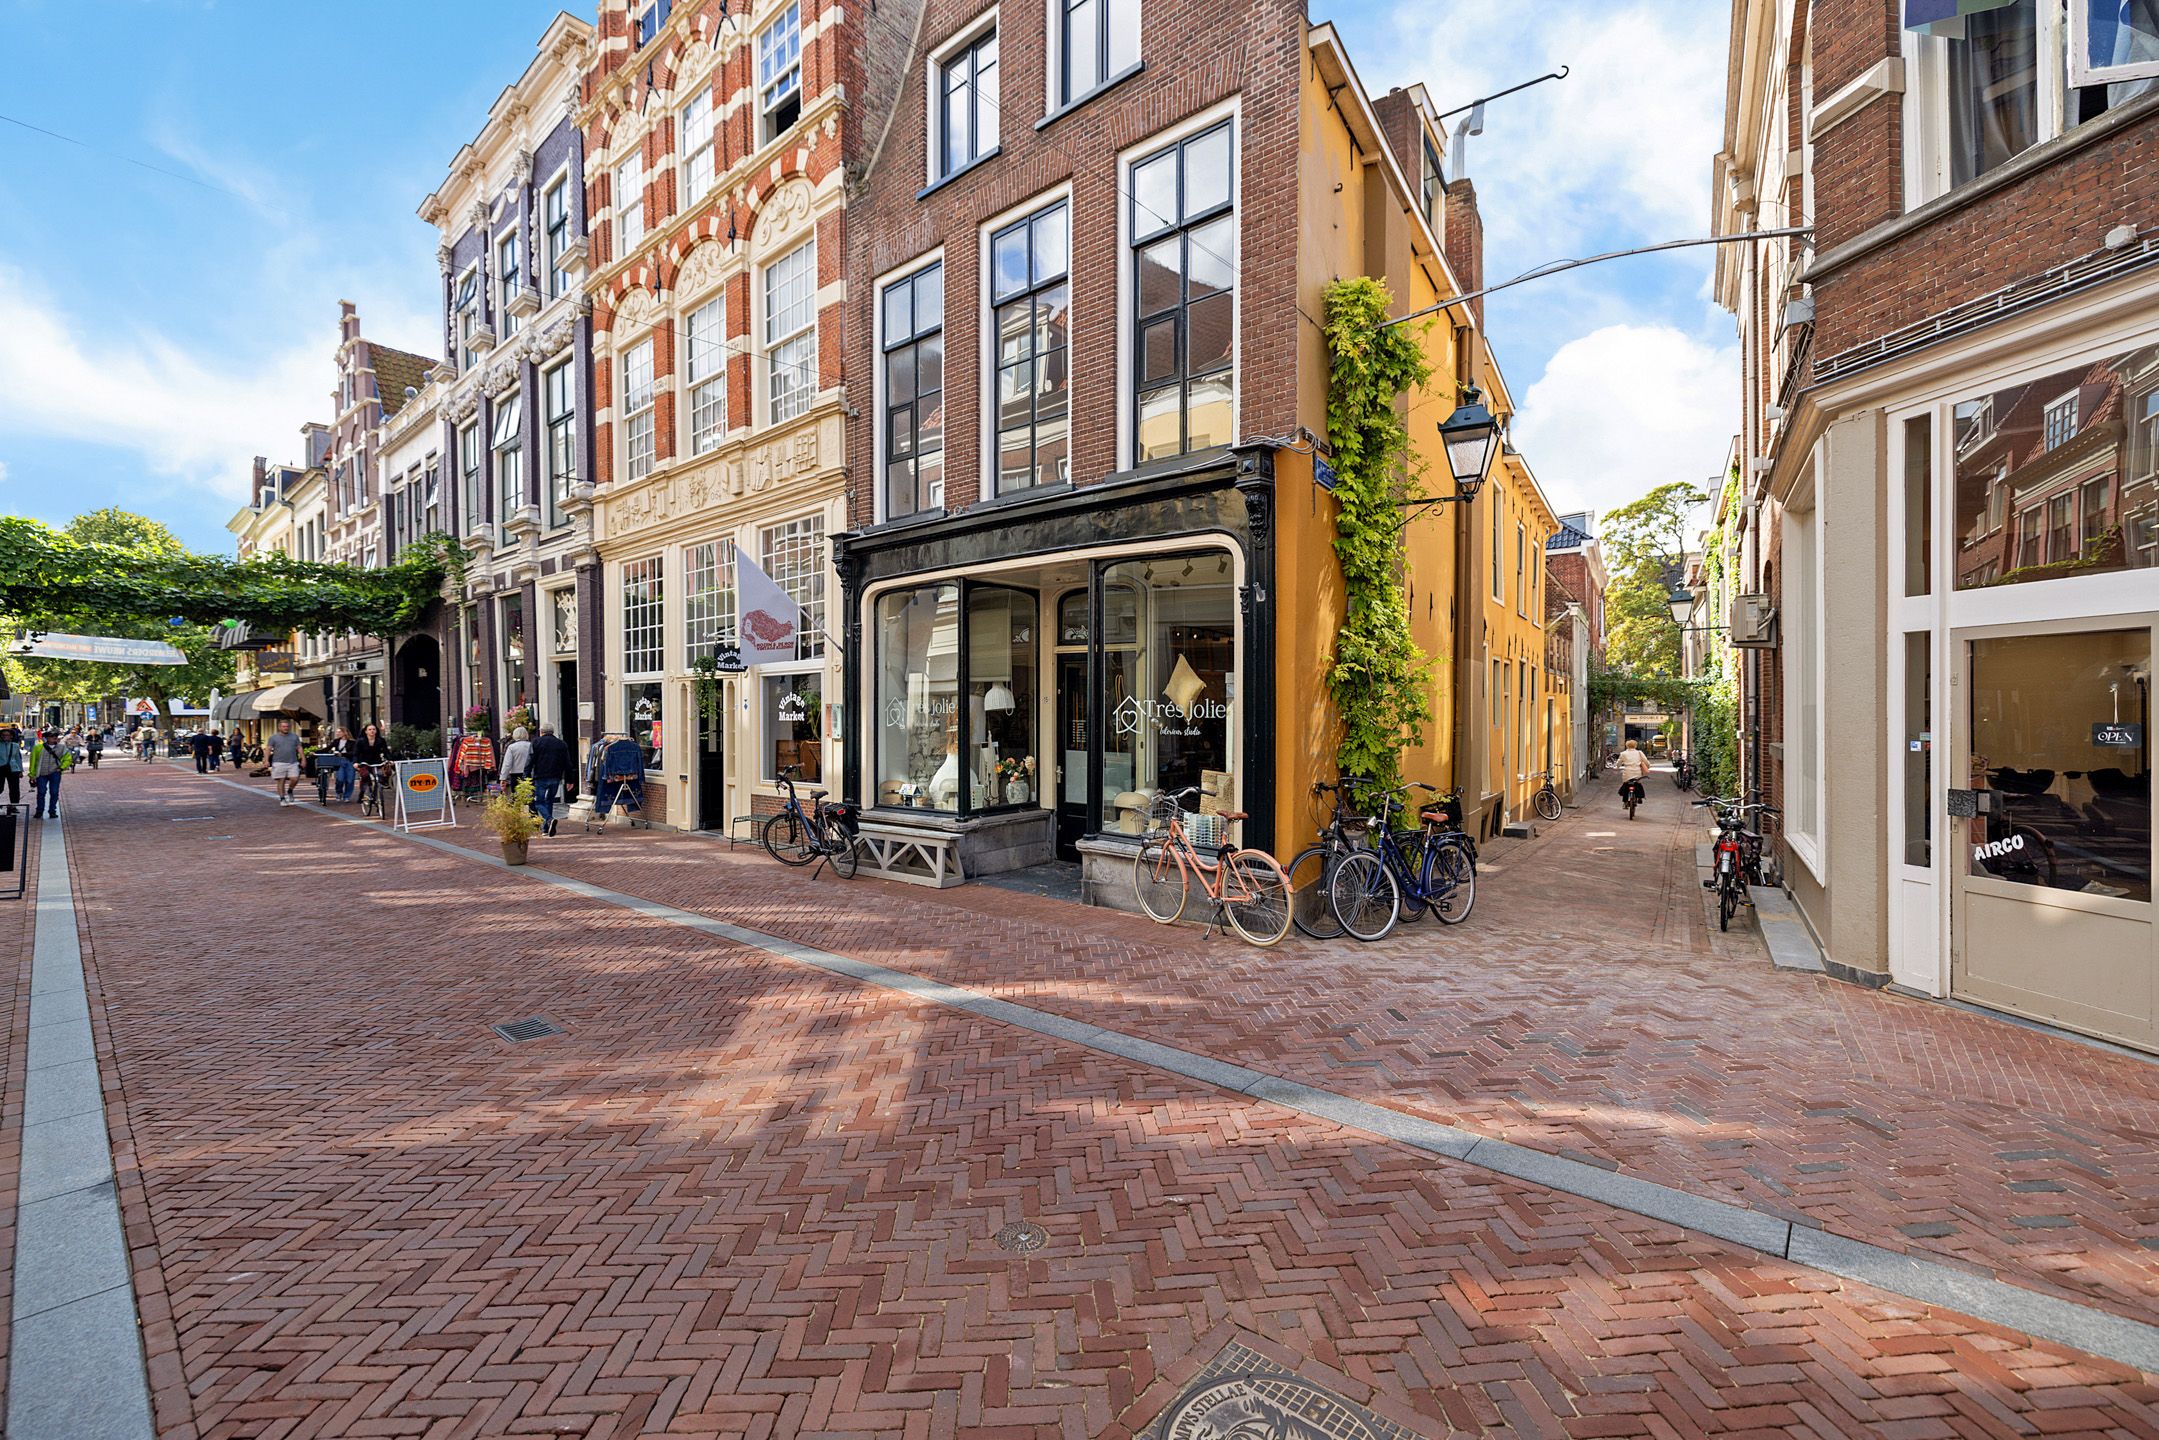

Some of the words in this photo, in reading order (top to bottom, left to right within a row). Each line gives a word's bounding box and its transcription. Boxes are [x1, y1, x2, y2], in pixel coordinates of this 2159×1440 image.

[716, 650, 741, 661] Vintag
[778, 691, 805, 710] Vintage
[930, 698, 956, 716] Jolie
[778, 711, 805, 721] Market
[1143, 699, 1184, 719] Trés
[1187, 698, 1226, 722] Jolie
[2097, 731, 2134, 742] OPEN
[1974, 834, 2025, 861] AIRCO
[1191, 1383, 1248, 1417] STELLAE
